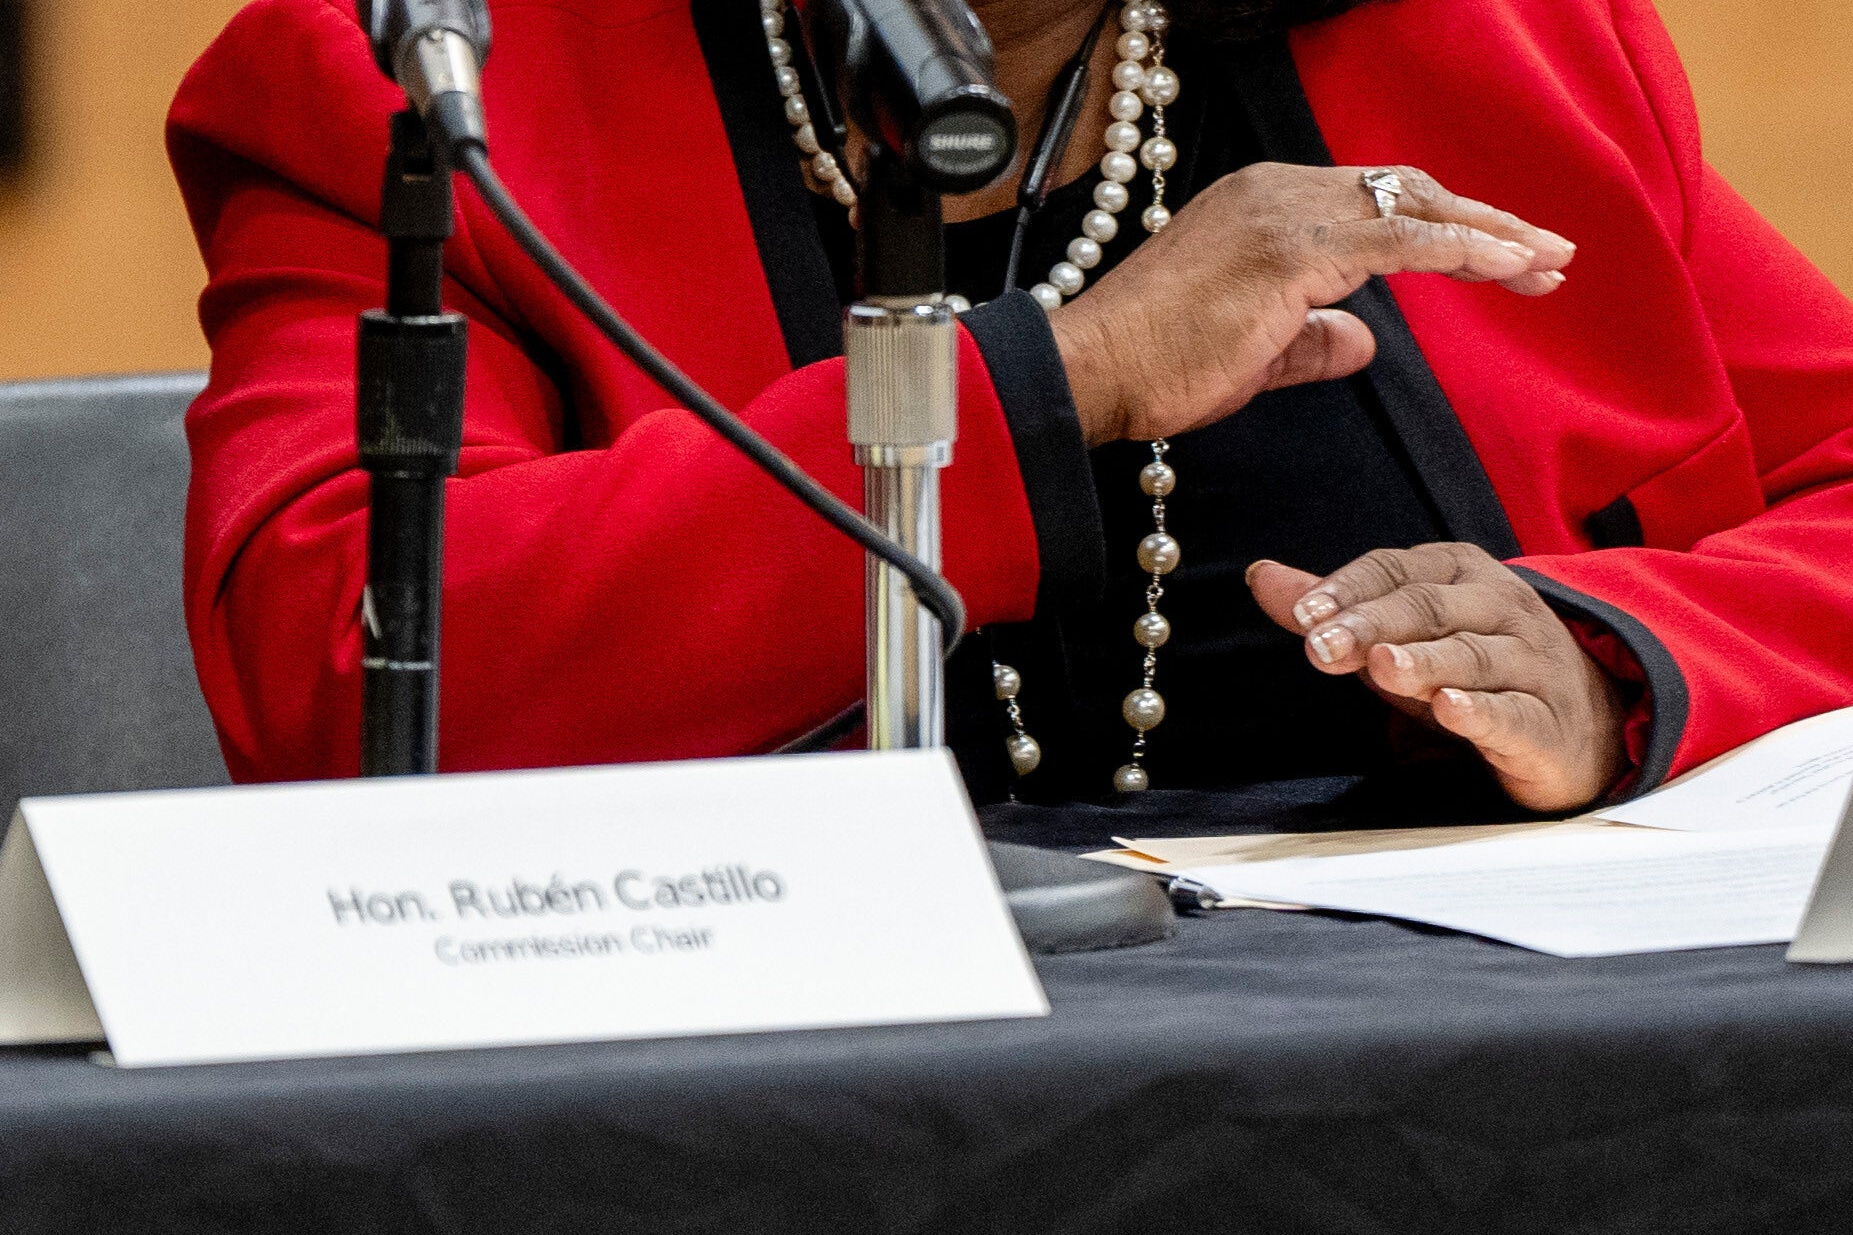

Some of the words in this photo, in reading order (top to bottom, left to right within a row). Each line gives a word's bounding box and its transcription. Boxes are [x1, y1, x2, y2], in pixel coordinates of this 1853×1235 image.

[326, 884, 437, 926] Hon.
[447, 872, 604, 922] Rubén
[613, 861, 786, 911] Castillo
[433, 930, 622, 966] Commission
[630, 923, 714, 955] Chair
